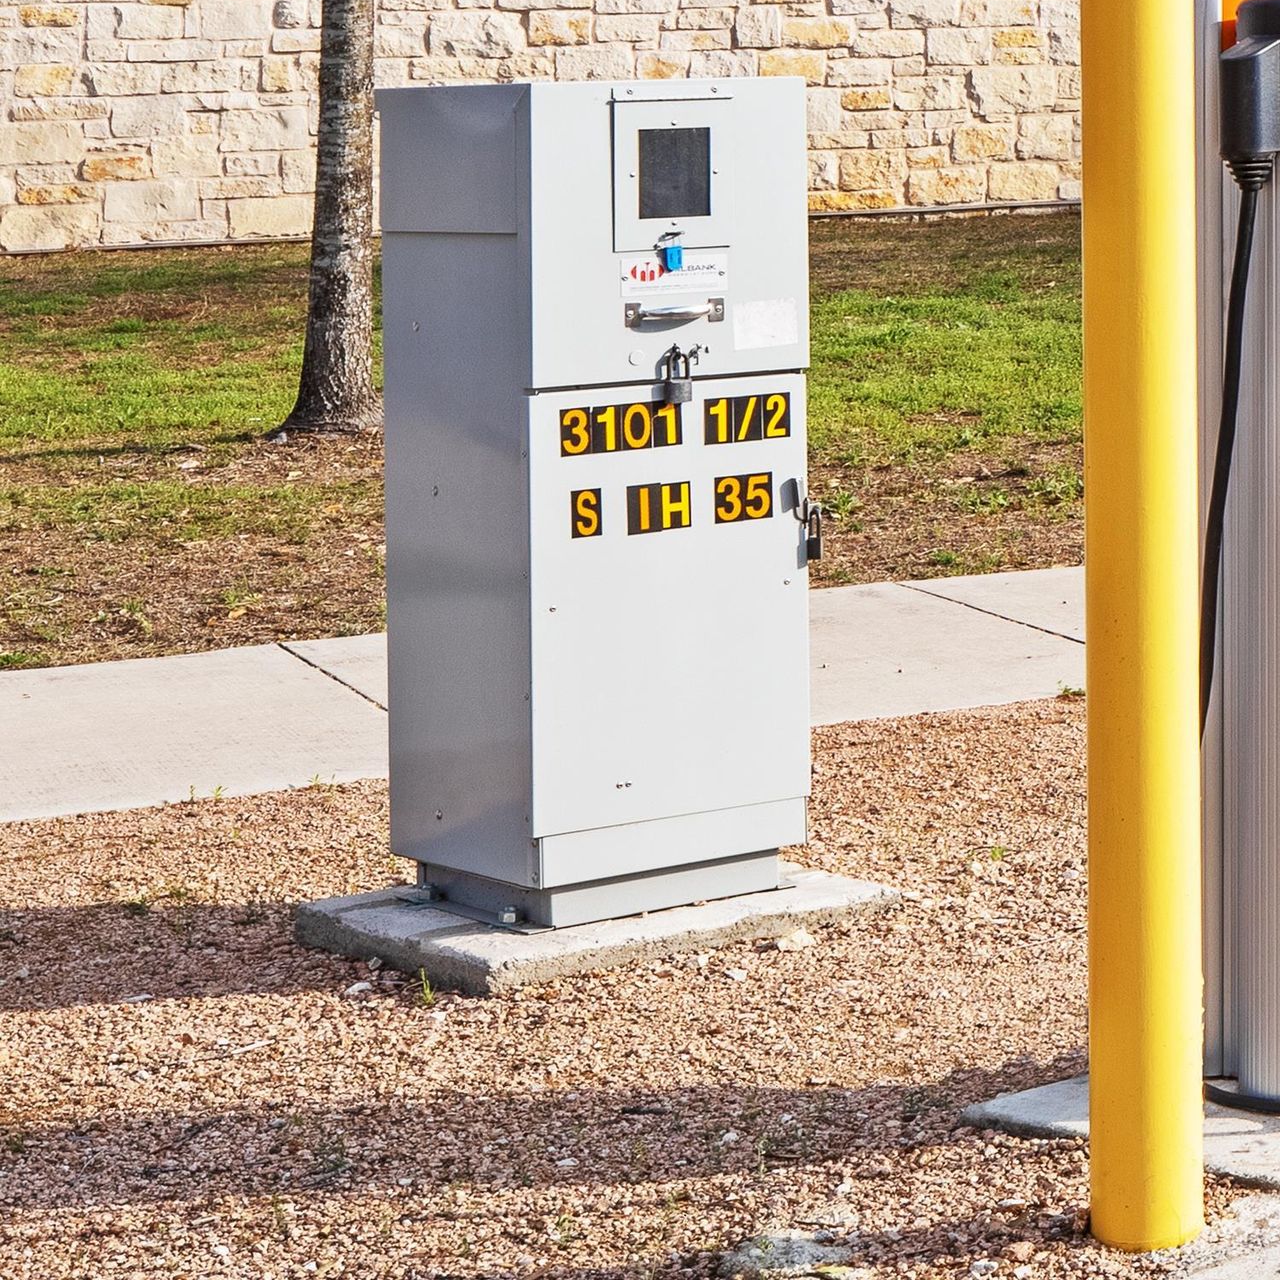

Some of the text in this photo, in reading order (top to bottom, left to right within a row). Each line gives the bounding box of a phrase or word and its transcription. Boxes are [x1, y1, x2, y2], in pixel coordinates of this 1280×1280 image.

[562, 394, 787, 454] 3101 1/2
[576, 474, 771, 536] S IH 35
